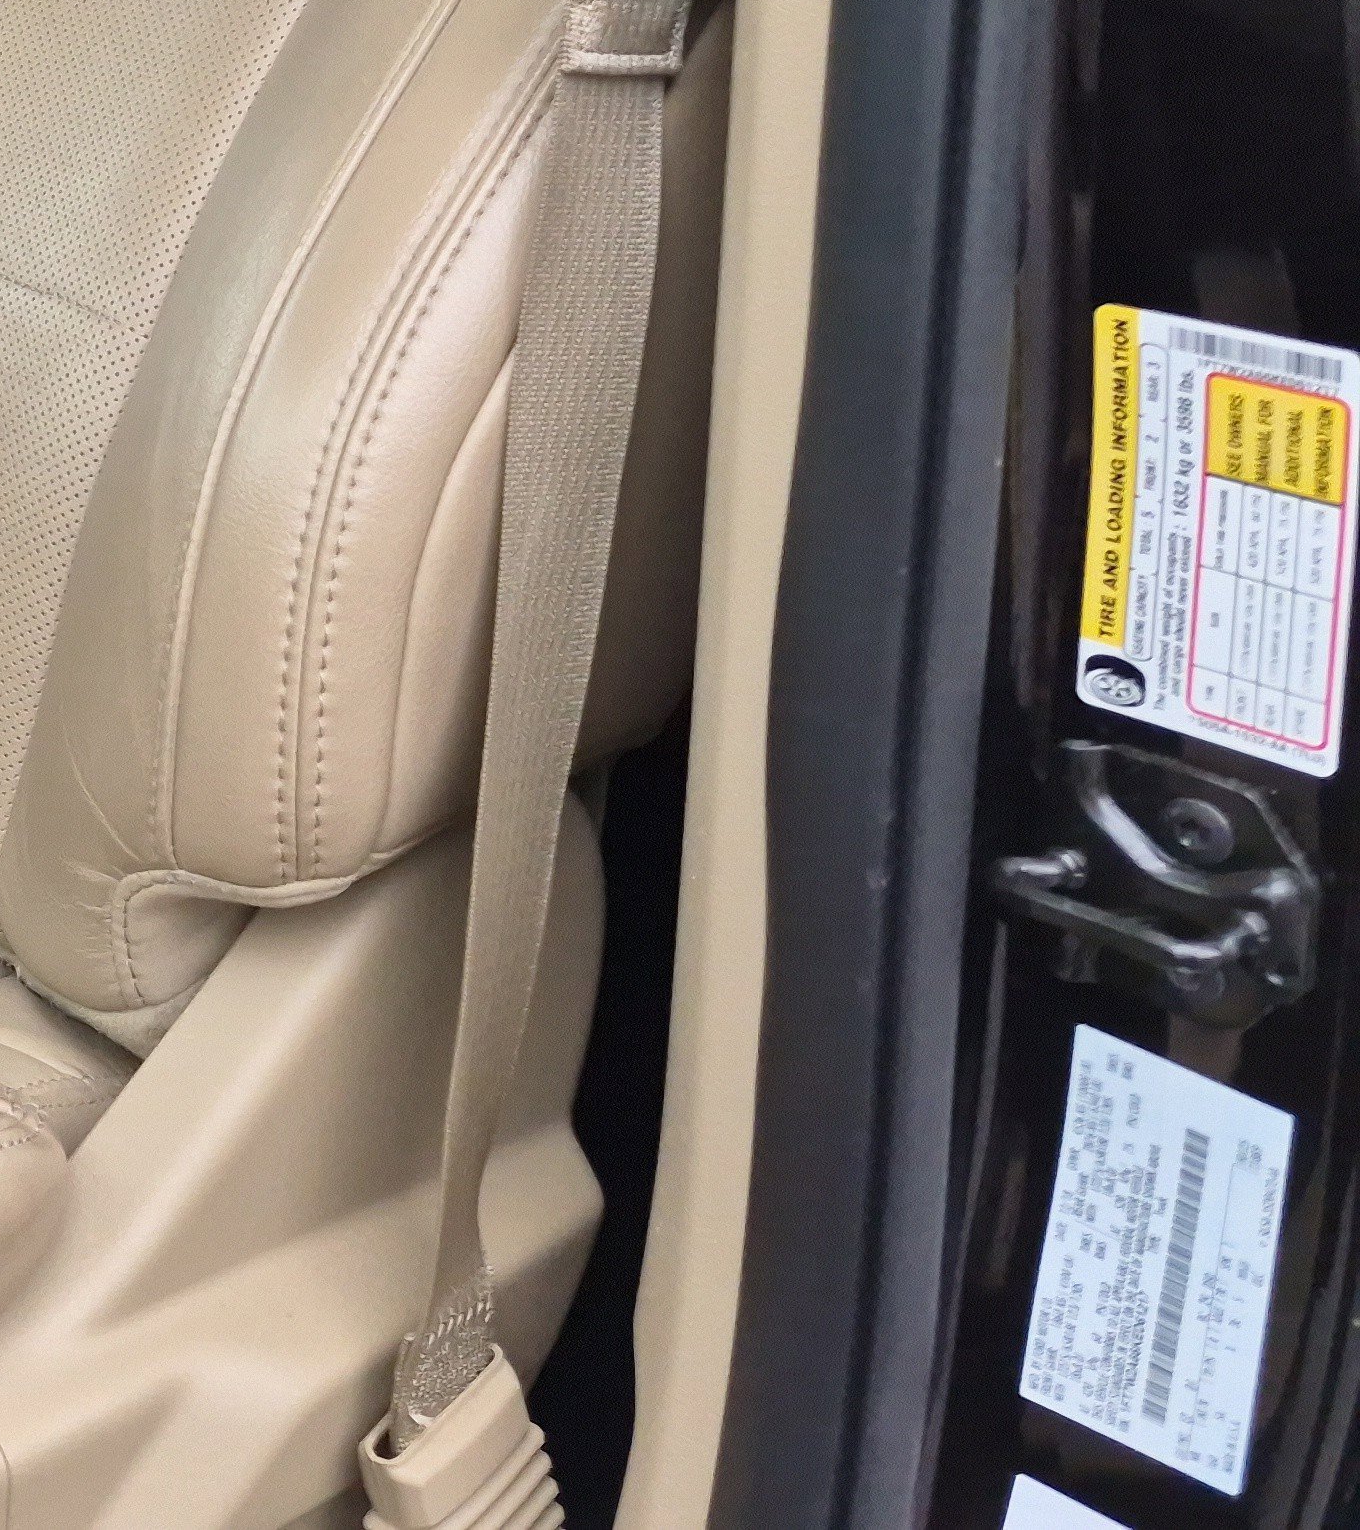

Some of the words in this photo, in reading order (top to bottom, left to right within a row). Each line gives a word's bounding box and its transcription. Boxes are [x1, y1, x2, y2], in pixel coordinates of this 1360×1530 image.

[1109, 319, 1129, 451] INFORMATION
[1145, 435, 1159, 443] 2
[1178, 440, 1192, 454] or
[1175, 459, 1195, 476] kg
[1104, 458, 1126, 543] LOADING
[1173, 480, 1191, 516] 1632
[1103, 550, 1119, 590] AND
[1098, 595, 1116, 638] TIRE
